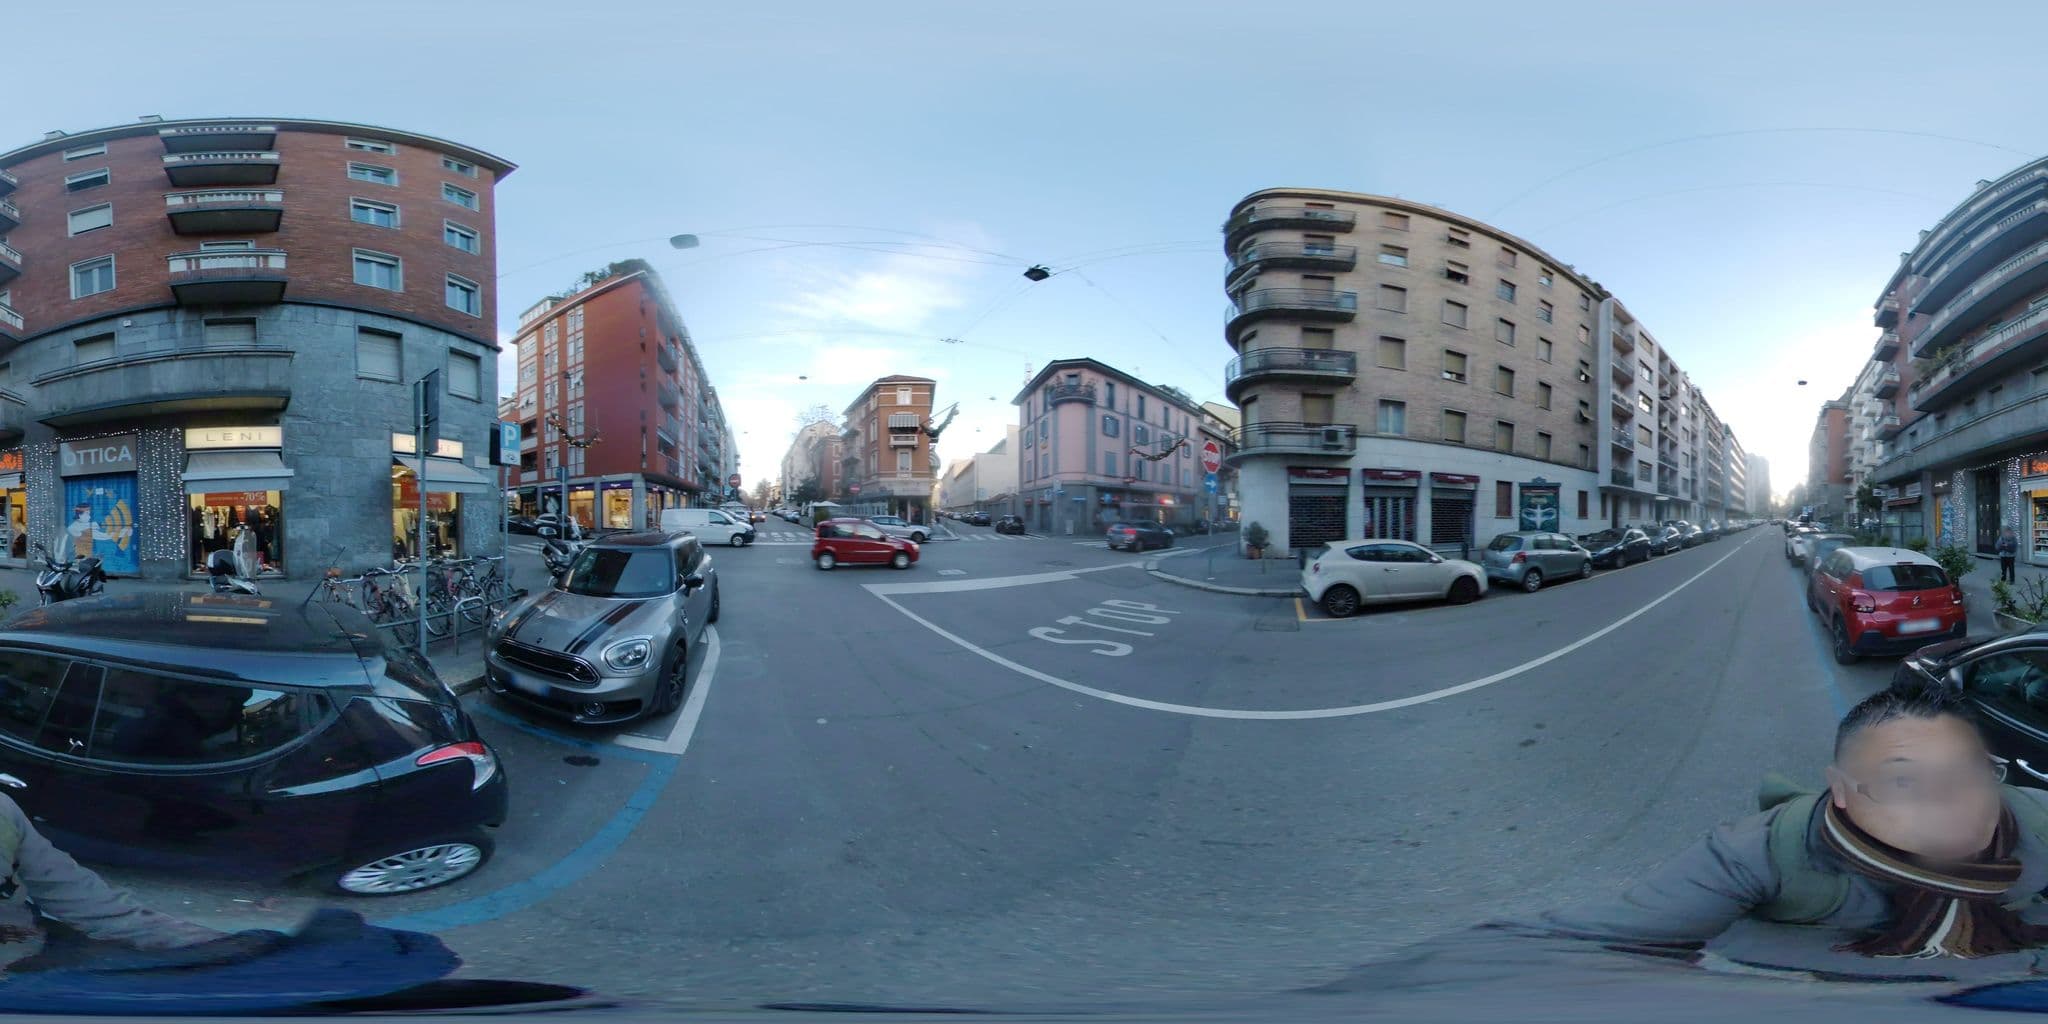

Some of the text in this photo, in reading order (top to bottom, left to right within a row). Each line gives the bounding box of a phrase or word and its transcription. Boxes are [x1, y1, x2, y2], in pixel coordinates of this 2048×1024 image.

[206, 432, 262, 441] LENI
[504, 426, 517, 447] P
[63, 445, 132, 466] OTTICA
[1028, 599, 1181, 657] STOP
